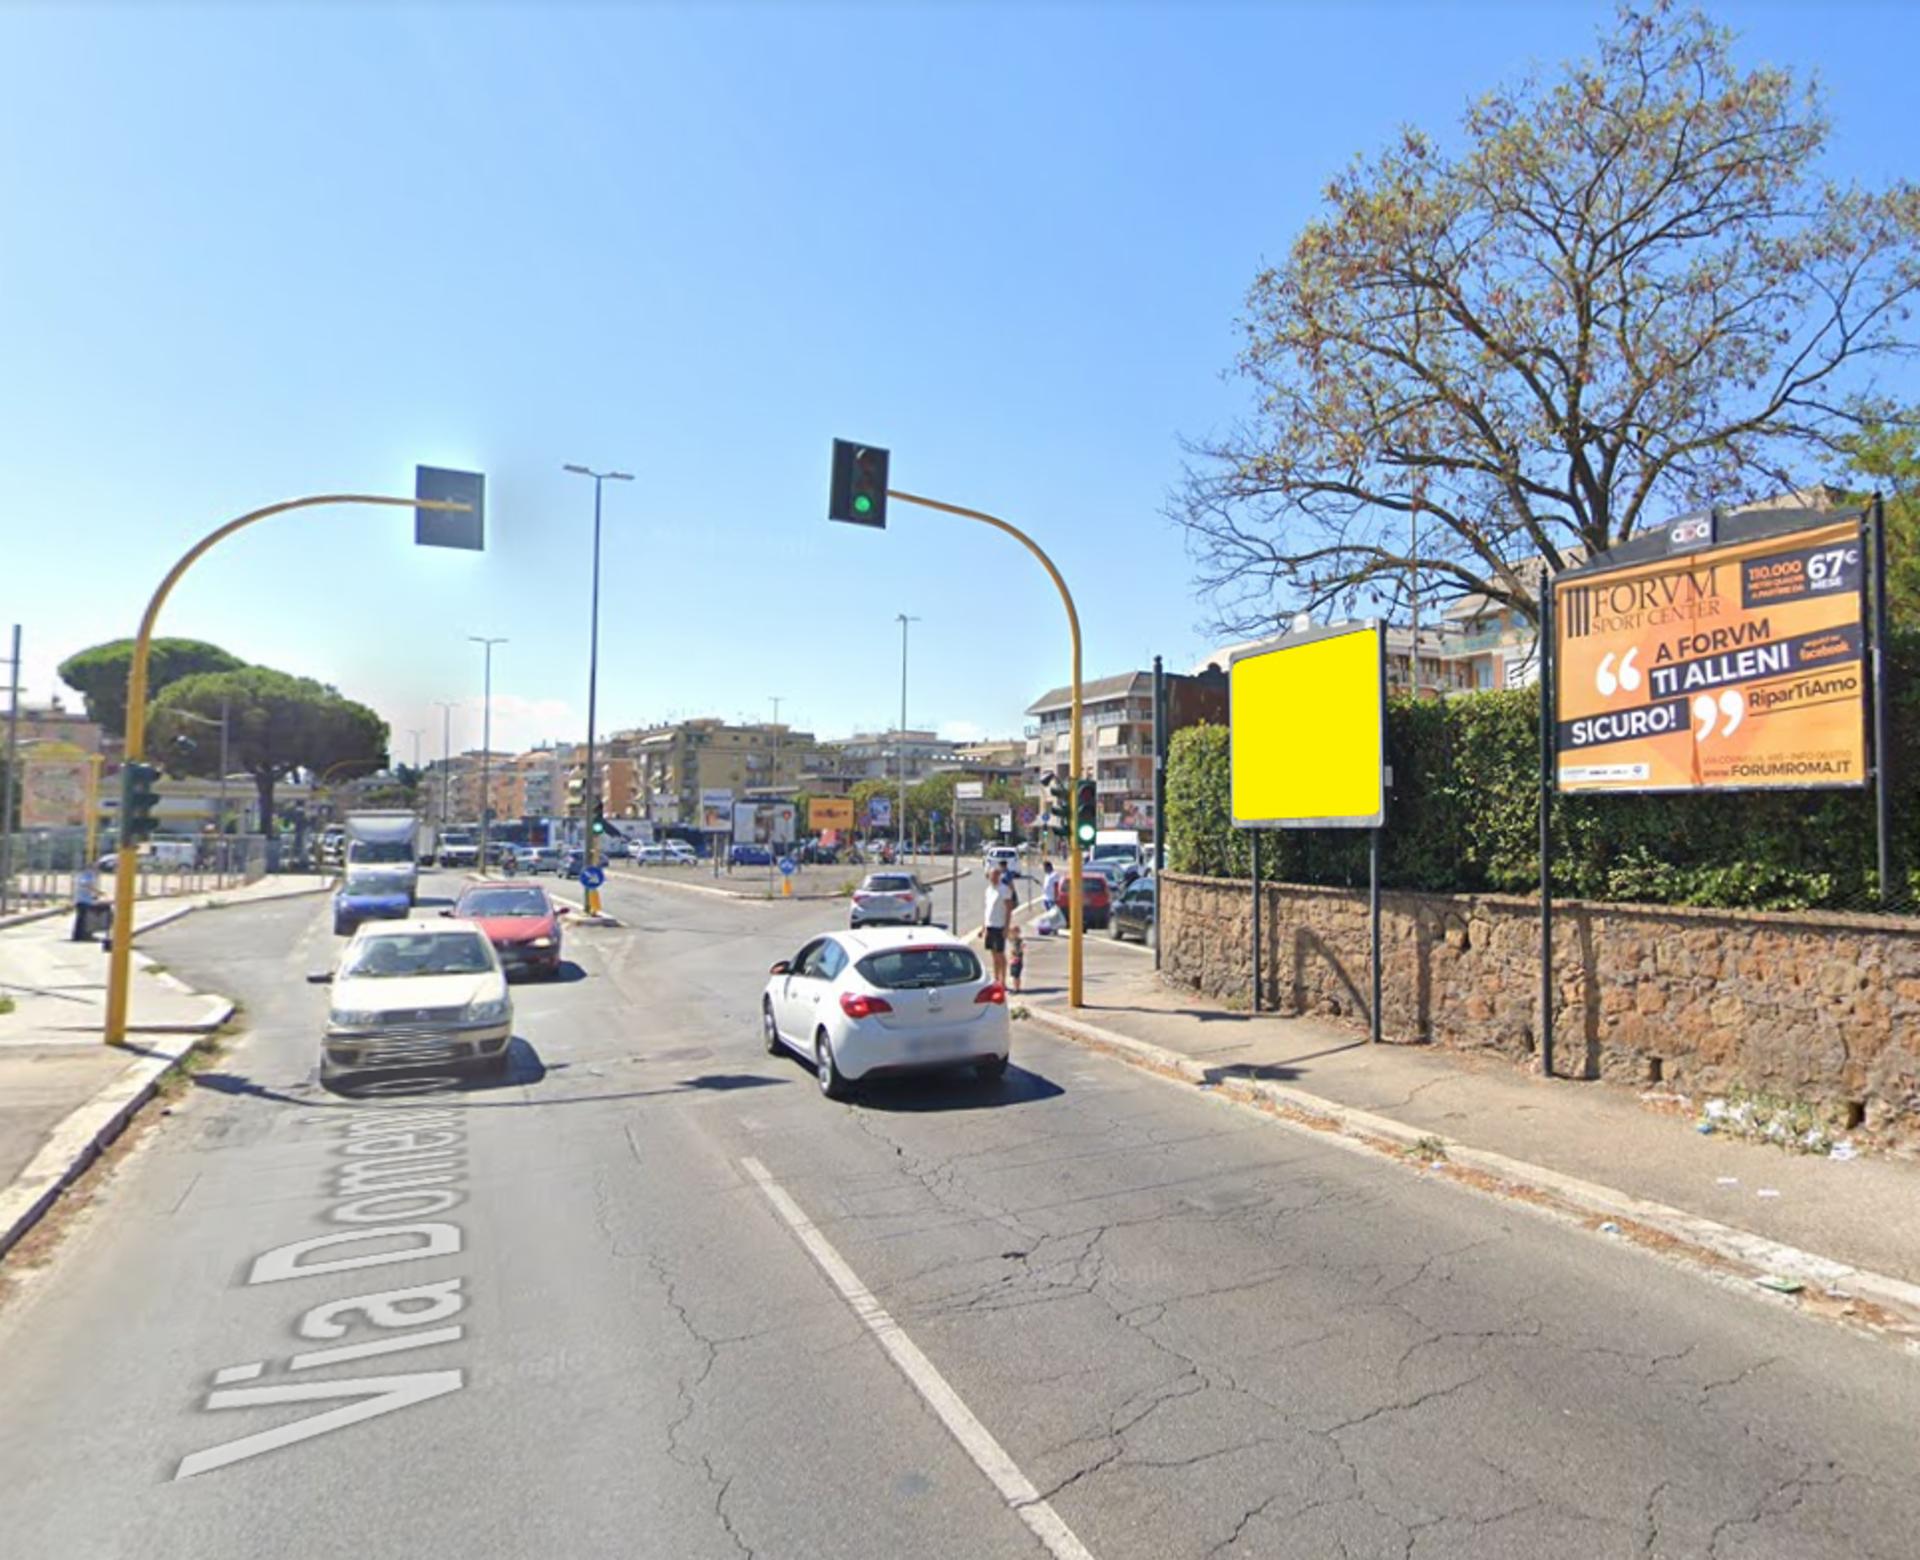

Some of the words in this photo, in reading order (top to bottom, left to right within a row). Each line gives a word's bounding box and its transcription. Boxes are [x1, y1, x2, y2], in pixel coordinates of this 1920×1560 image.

[1593, 566, 1718, 617] FORVM
[1592, 611, 1643, 635] SPORT
[1647, 600, 1720, 626] CENTER
[1655, 642, 1673, 663] A
[1678, 618, 1771, 657] FORVM
[1652, 667, 1678, 694] TI
[1683, 643, 1790, 689] ALLENI
[1749, 677, 1857, 709] RiparTiAmo
[1571, 704, 1677, 745] SICURO!
